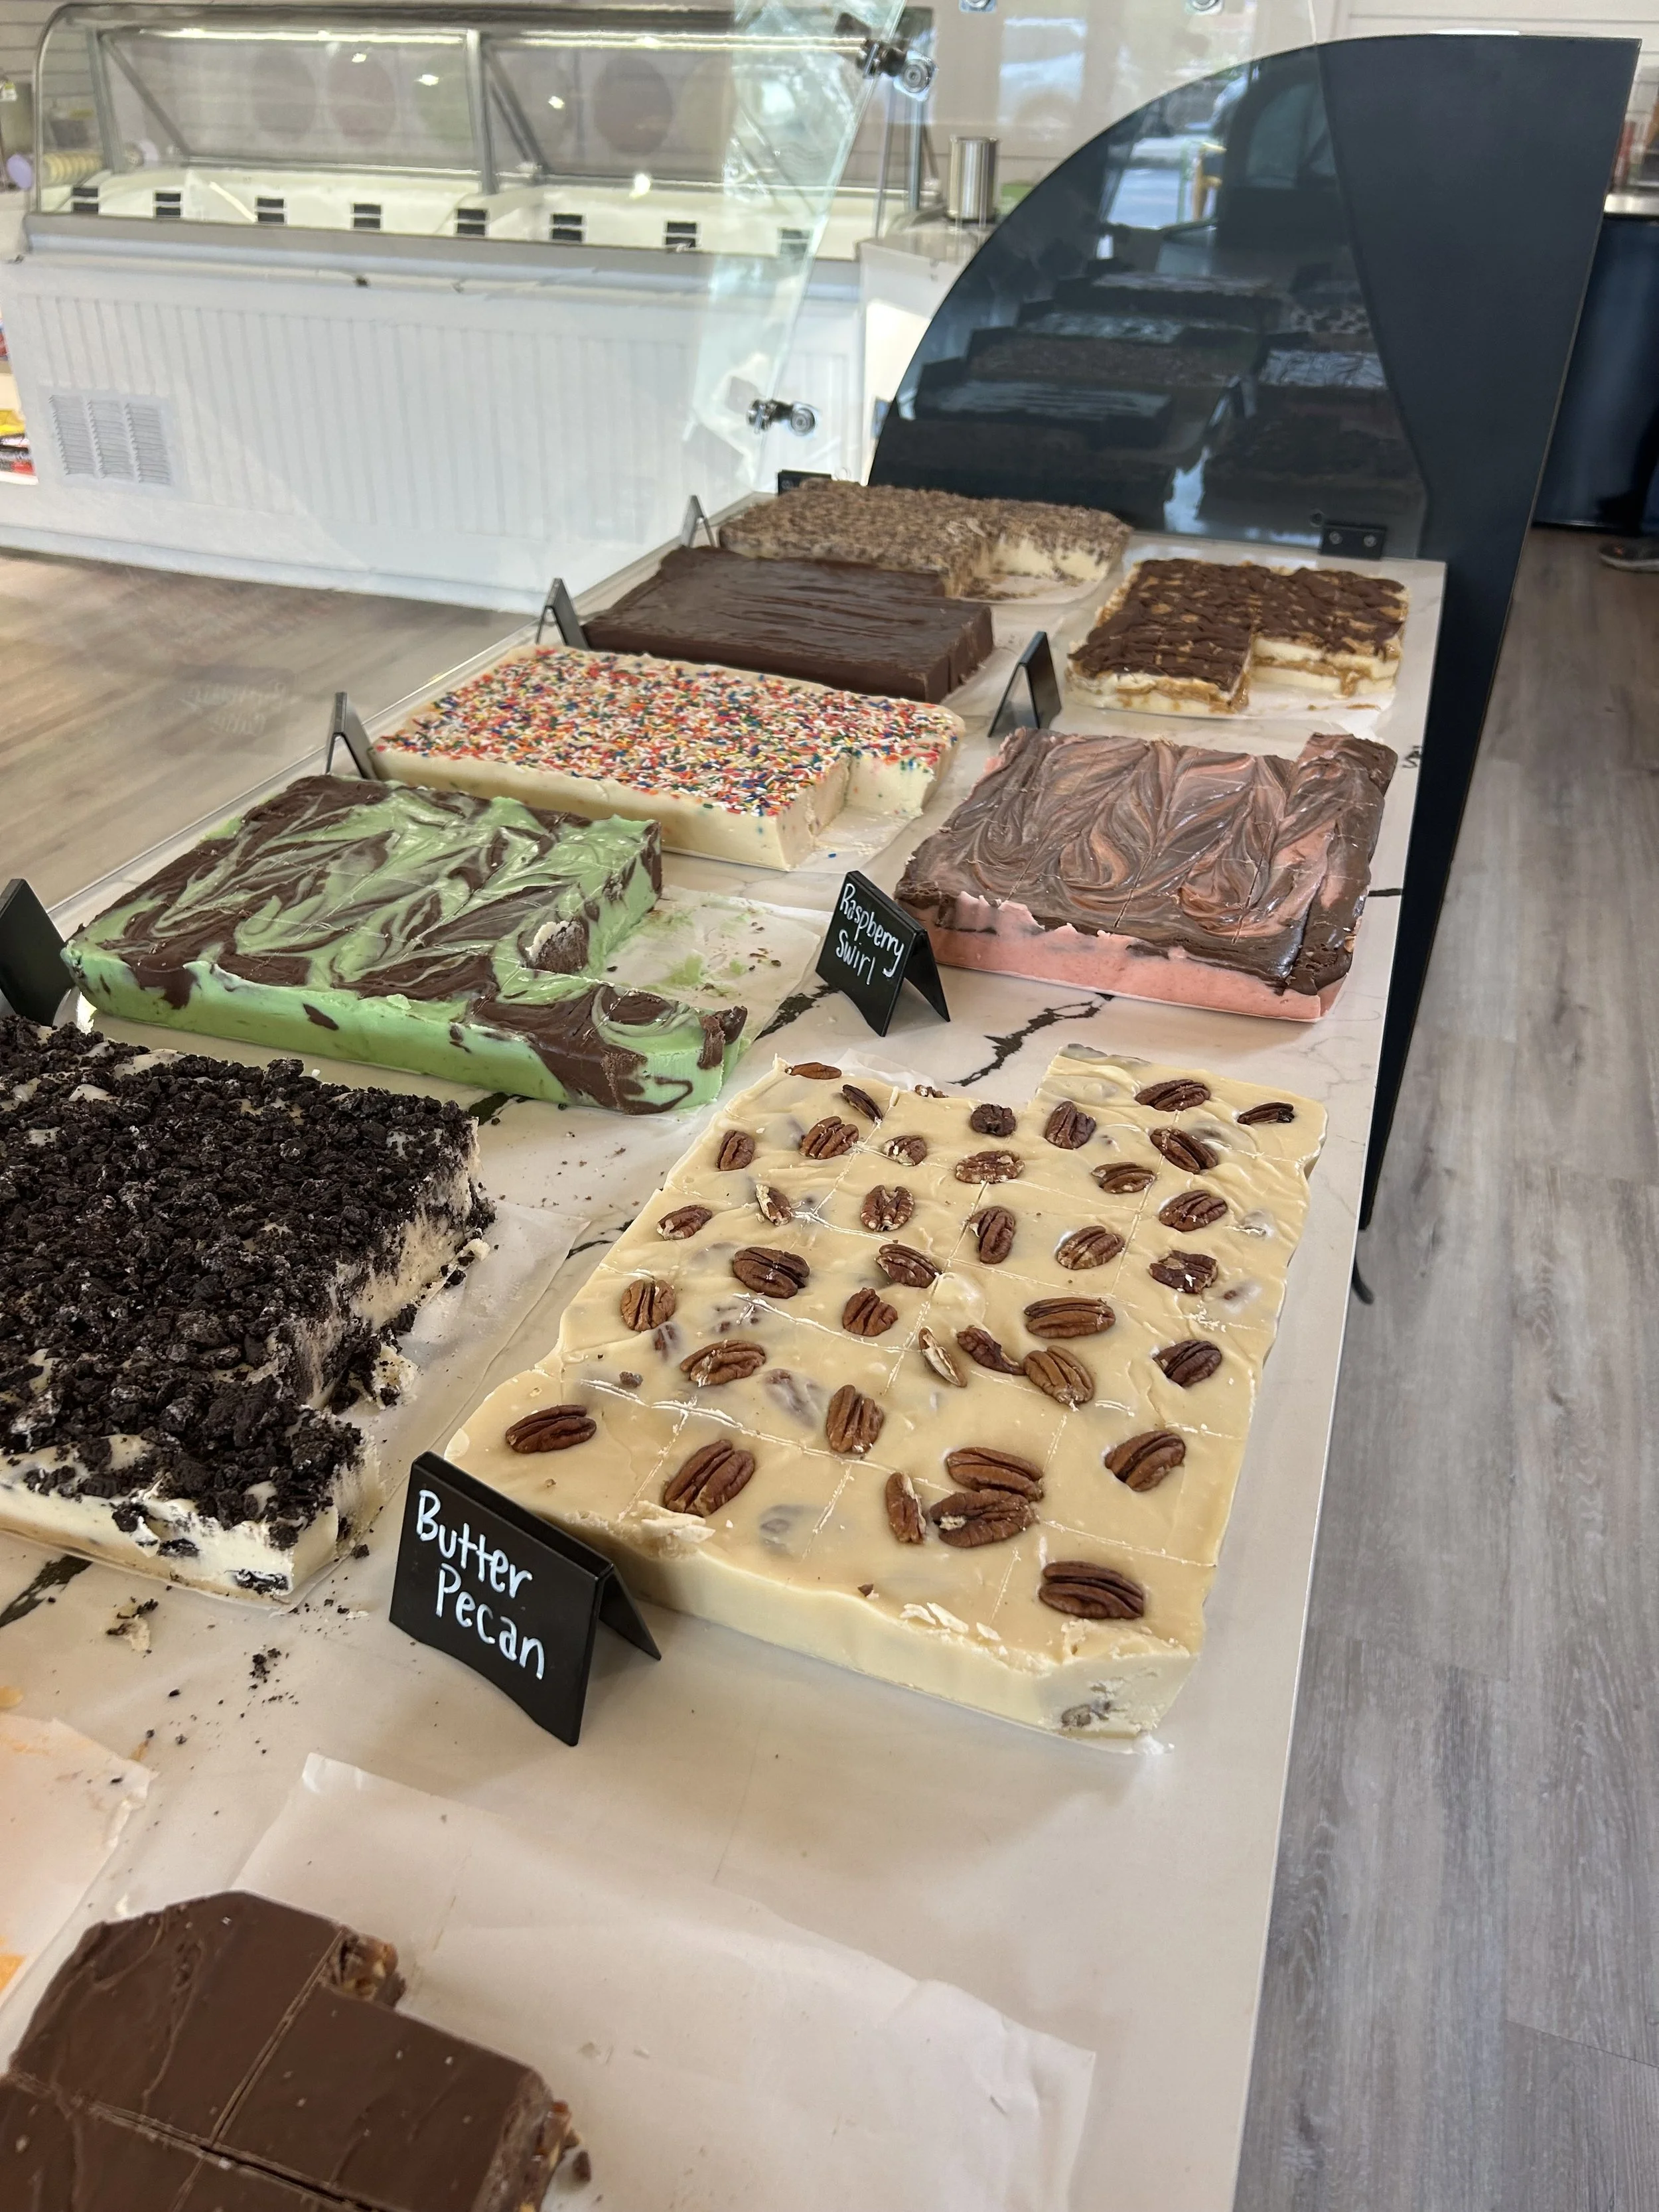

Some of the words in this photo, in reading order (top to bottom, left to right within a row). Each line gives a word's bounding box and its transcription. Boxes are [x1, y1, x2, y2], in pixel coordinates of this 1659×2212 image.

[835, 929, 876, 985] Swirl
[839, 883, 904, 978] Raspberry
[416, 1489, 533, 1599] Butter
[435, 1562, 545, 1680] Pecan
